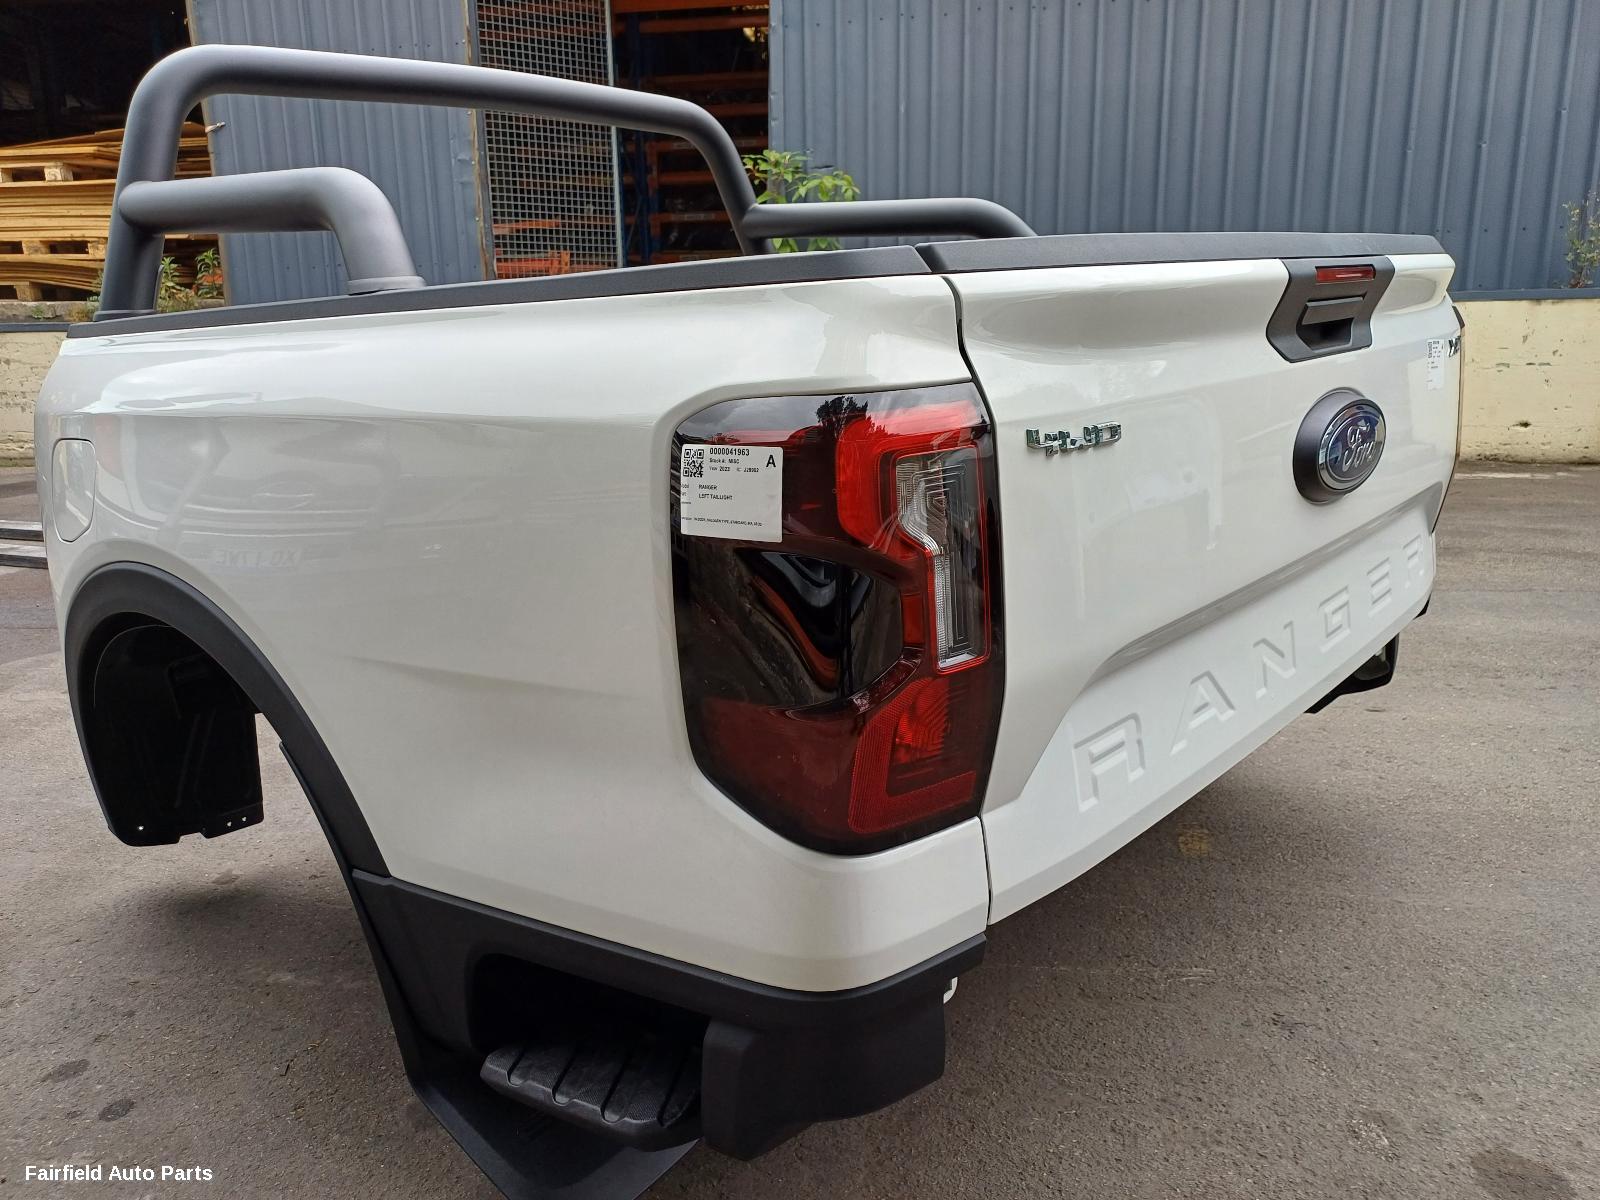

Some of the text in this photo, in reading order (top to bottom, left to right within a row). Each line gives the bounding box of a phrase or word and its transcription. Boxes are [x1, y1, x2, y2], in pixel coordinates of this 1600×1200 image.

[709, 447, 750, 456] 0000041963
[765, 454, 777, 468] A
[1342, 424, 1376, 472] Ford
[1073, 534, 1425, 812] RANGER
